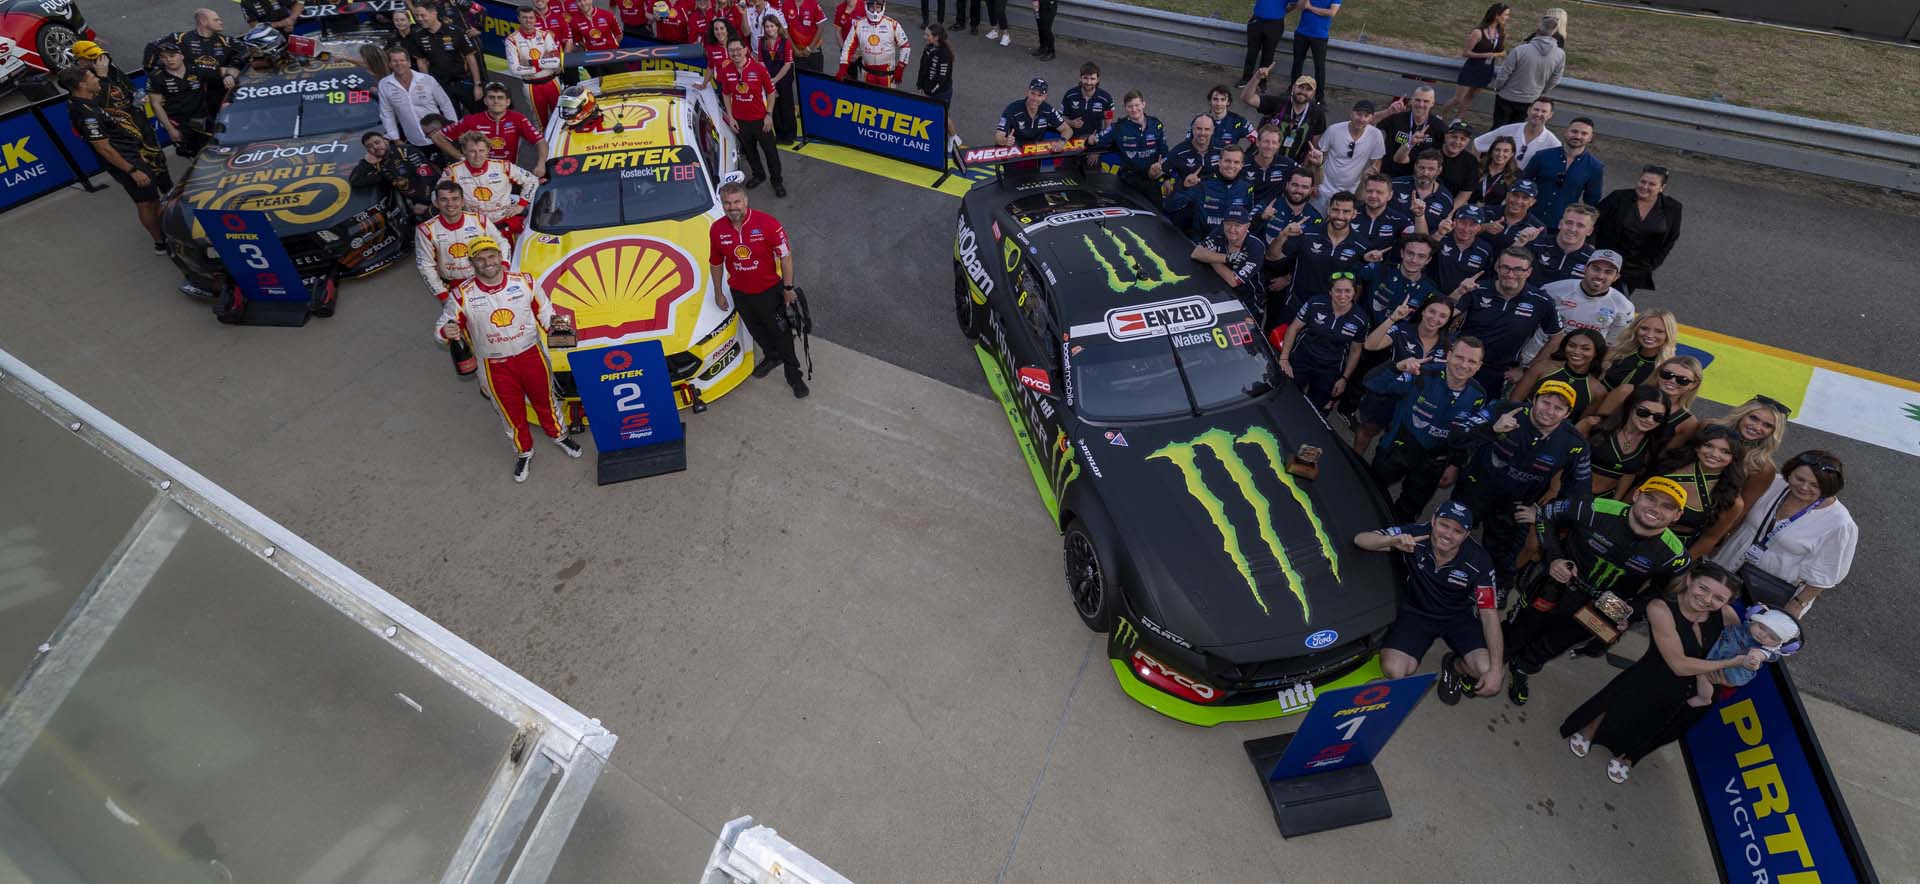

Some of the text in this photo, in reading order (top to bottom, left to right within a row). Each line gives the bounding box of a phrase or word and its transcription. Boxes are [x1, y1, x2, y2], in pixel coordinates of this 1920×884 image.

[235, 77, 339, 100] Steadfast
[326, 92, 345, 104] 19
[834, 99, 933, 140] PIRTEK
[234, 140, 348, 164] airtouch
[586, 140, 653, 152] Shell V-Power
[857, 127, 930, 152] VICTORY LANE
[581, 147, 683, 173] PIRTEK
[967, 146, 1022, 161] MEGA
[5, 164, 47, 187] LANE
[217, 163, 337, 188] PENRITE
[620, 167, 653, 179] Kostecki
[652, 165, 671, 182] 17
[239, 244, 270, 269] 3
[1018, 290, 1028, 308] 6
[1145, 303, 1207, 328] ENZED
[1172, 331, 1212, 349] Waters
[1211, 327, 1228, 349] 6
[600, 368, 644, 382] PIRTEK
[1020, 375, 1051, 392] RYCO
[613, 382, 646, 412] 2
[1081, 444, 1103, 479] DUNLOP
[1134, 650, 1215, 699] RYCO
[1277, 681, 1316, 711] nti
[1332, 701, 1392, 719] PIRTEK
[1335, 715, 1367, 742] 1
[1720, 698, 1822, 884] PIRT
[1724, 777, 1770, 884] VICTOR
